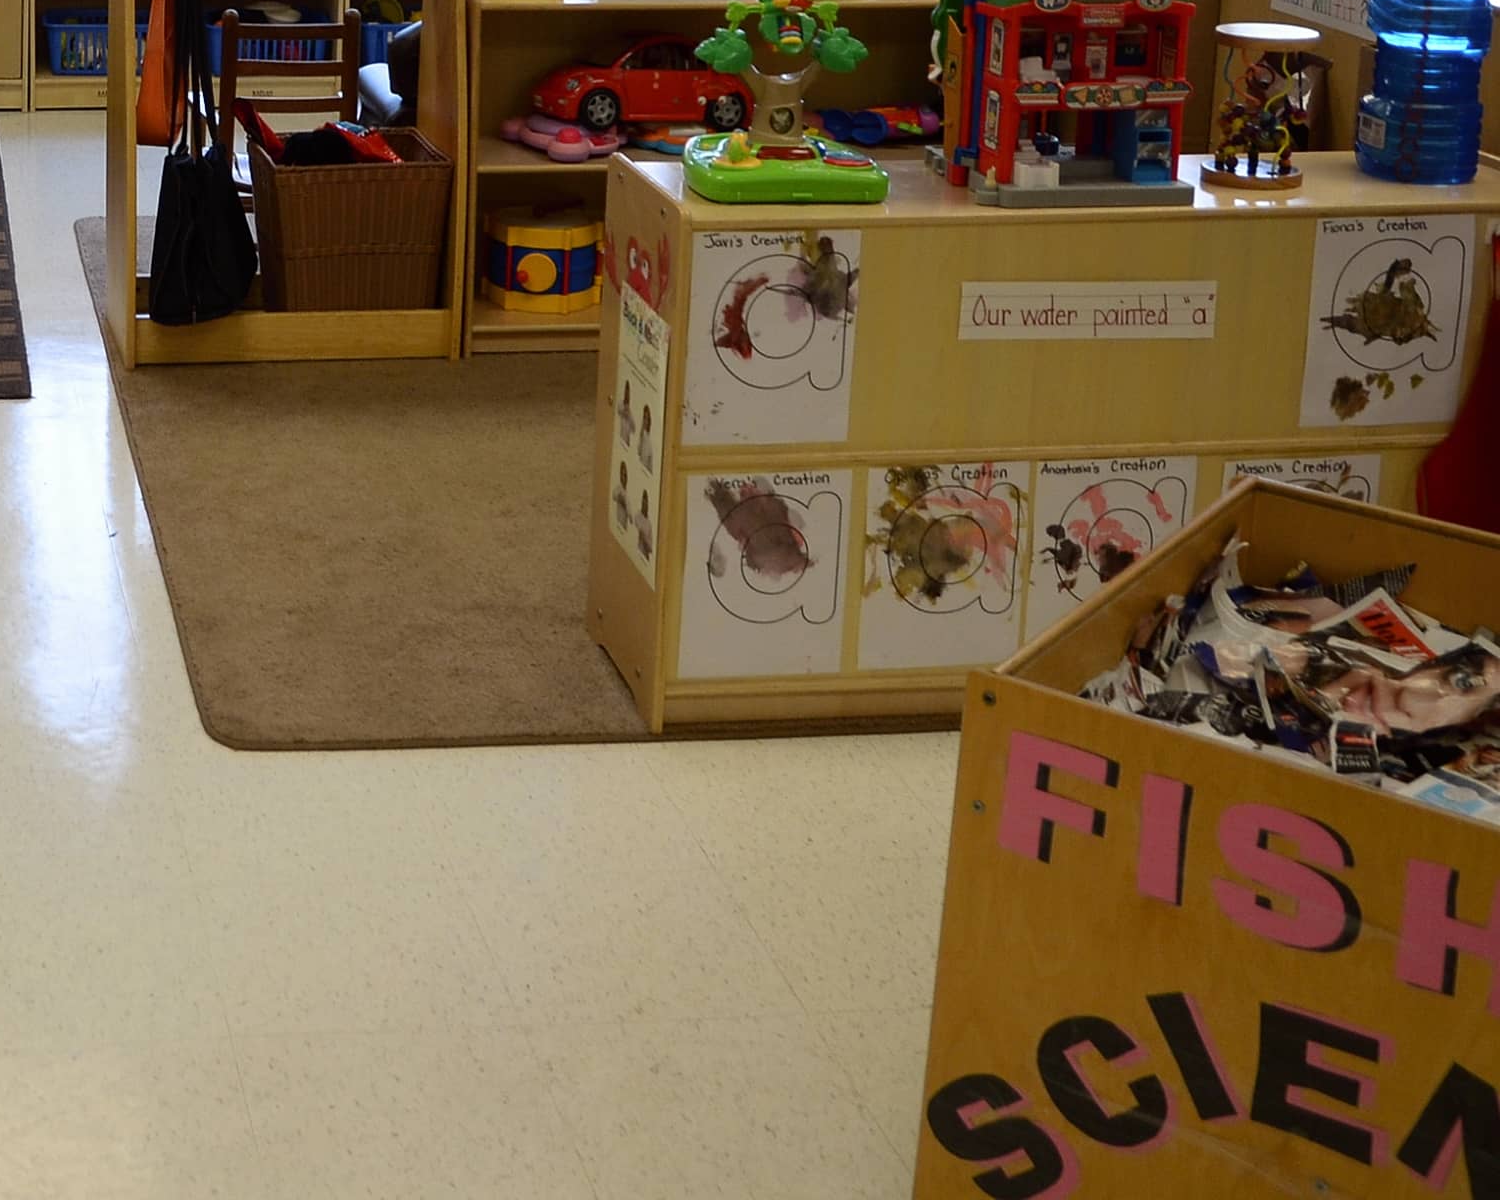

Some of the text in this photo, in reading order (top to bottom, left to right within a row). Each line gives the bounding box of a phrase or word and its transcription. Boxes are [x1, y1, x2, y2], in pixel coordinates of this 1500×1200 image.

[1322, 217, 1428, 234] Fiona's Creation
[751, 233, 806, 247] Creation
[971, 293, 1011, 326] Our
[1020, 294, 1078, 326] water
[1092, 293, 1168, 337] painted
[1110, 458, 1168, 472] Creation
[1292, 459, 1349, 474] Creation
[772, 472, 831, 487] Creation
[950, 465, 1008, 481] Creation
